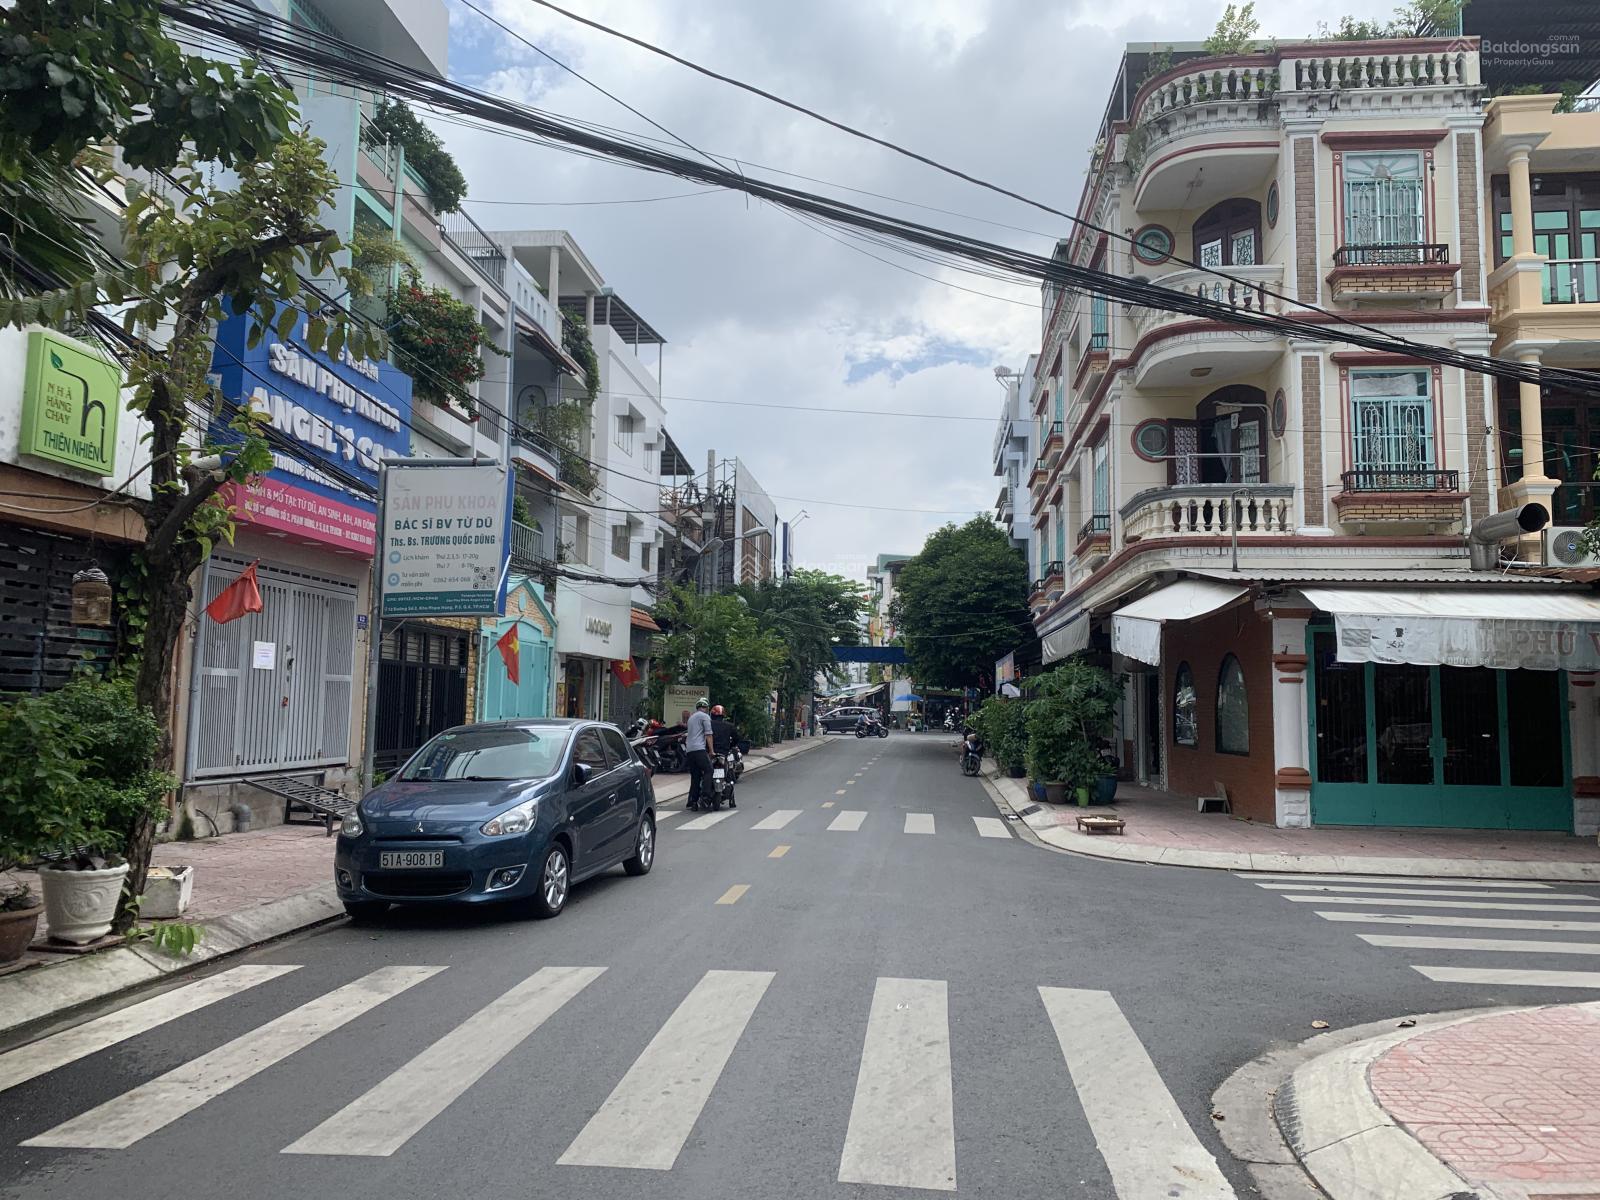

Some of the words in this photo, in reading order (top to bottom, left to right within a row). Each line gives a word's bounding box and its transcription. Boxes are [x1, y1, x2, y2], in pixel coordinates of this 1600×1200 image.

[46, 395, 72, 413] HÀNG
[45, 408, 71, 424] CHAY
[43, 429, 70, 454] THIÊN
[71, 440, 100, 462] NHIÊN
[458, 495, 497, 510] KHOA
[395, 517, 418, 530] BÁC
[436, 518, 453, 529] BV
[456, 516, 474, 529] TỪ
[475, 516, 493, 528] DŨ
[390, 536, 405, 547] Ths.
[407, 536, 419, 546] Bs.
[421, 535, 450, 546] TRƯƠNG
[452, 533, 473, 545] QUỐC
[382, 853, 441, 867] 51A-908.18
